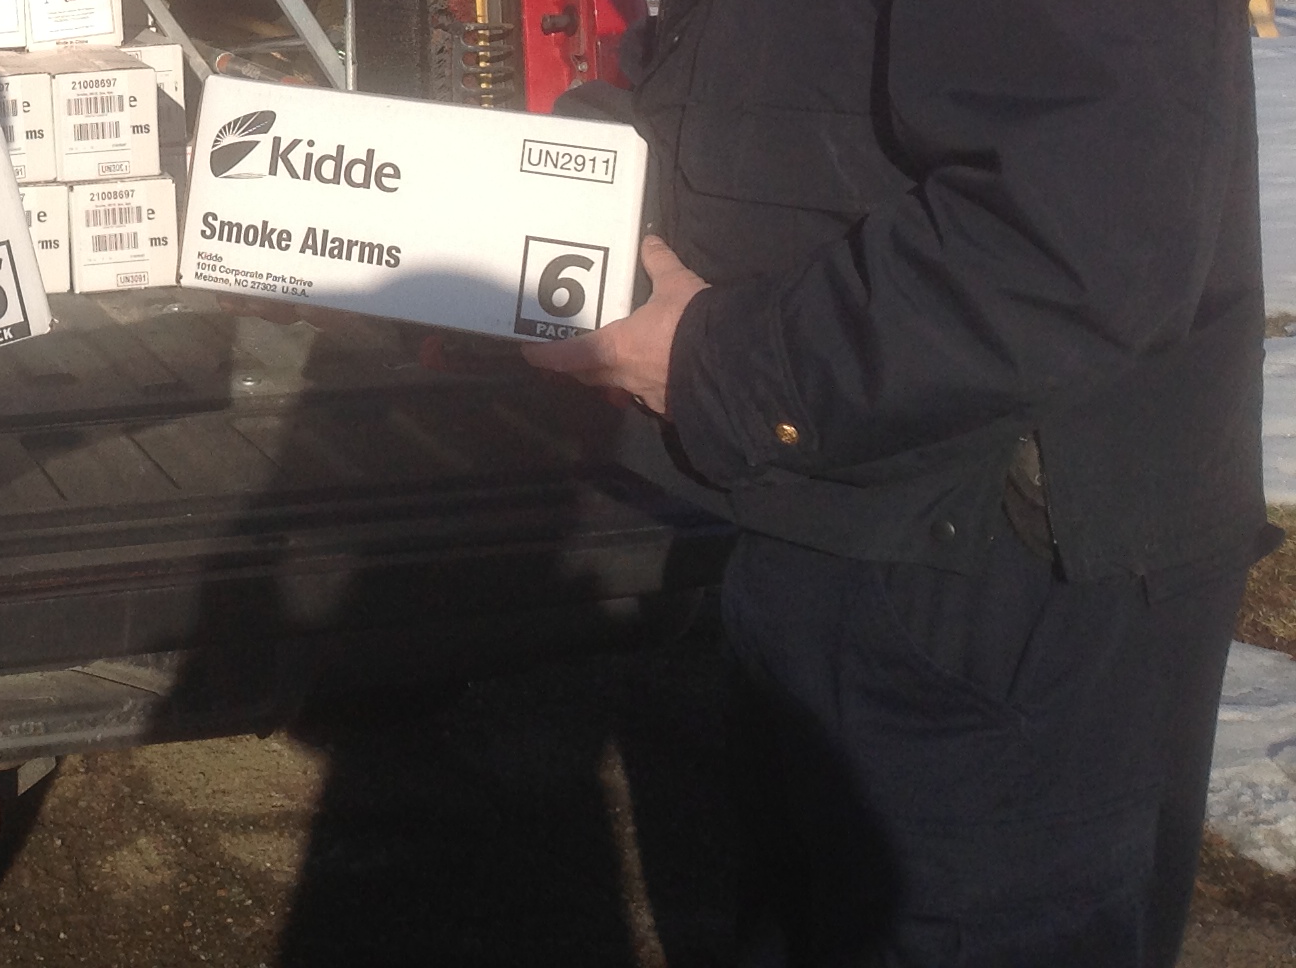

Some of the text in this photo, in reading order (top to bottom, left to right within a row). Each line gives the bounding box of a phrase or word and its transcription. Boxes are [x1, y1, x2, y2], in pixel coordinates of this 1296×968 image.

[71, 78, 117, 91] 21008697
[267, 134, 402, 193] Kidde
[527, 147, 610, 176] UN2911
[89, 189, 135, 202] 21008697
[200, 211, 402, 268] Smoke Alarms
[197, 251, 223, 263] Kidde
[194, 272, 232, 286] Mebane,
[234, 277, 249, 288] NC
[250, 280, 277, 292] 27302
[219, 265, 264, 280] Corporate
[265, 273, 287, 283] Park
[289, 276, 314, 288] Drive
[537, 254, 595, 318] 6
[536, 322, 578, 339] PACK
